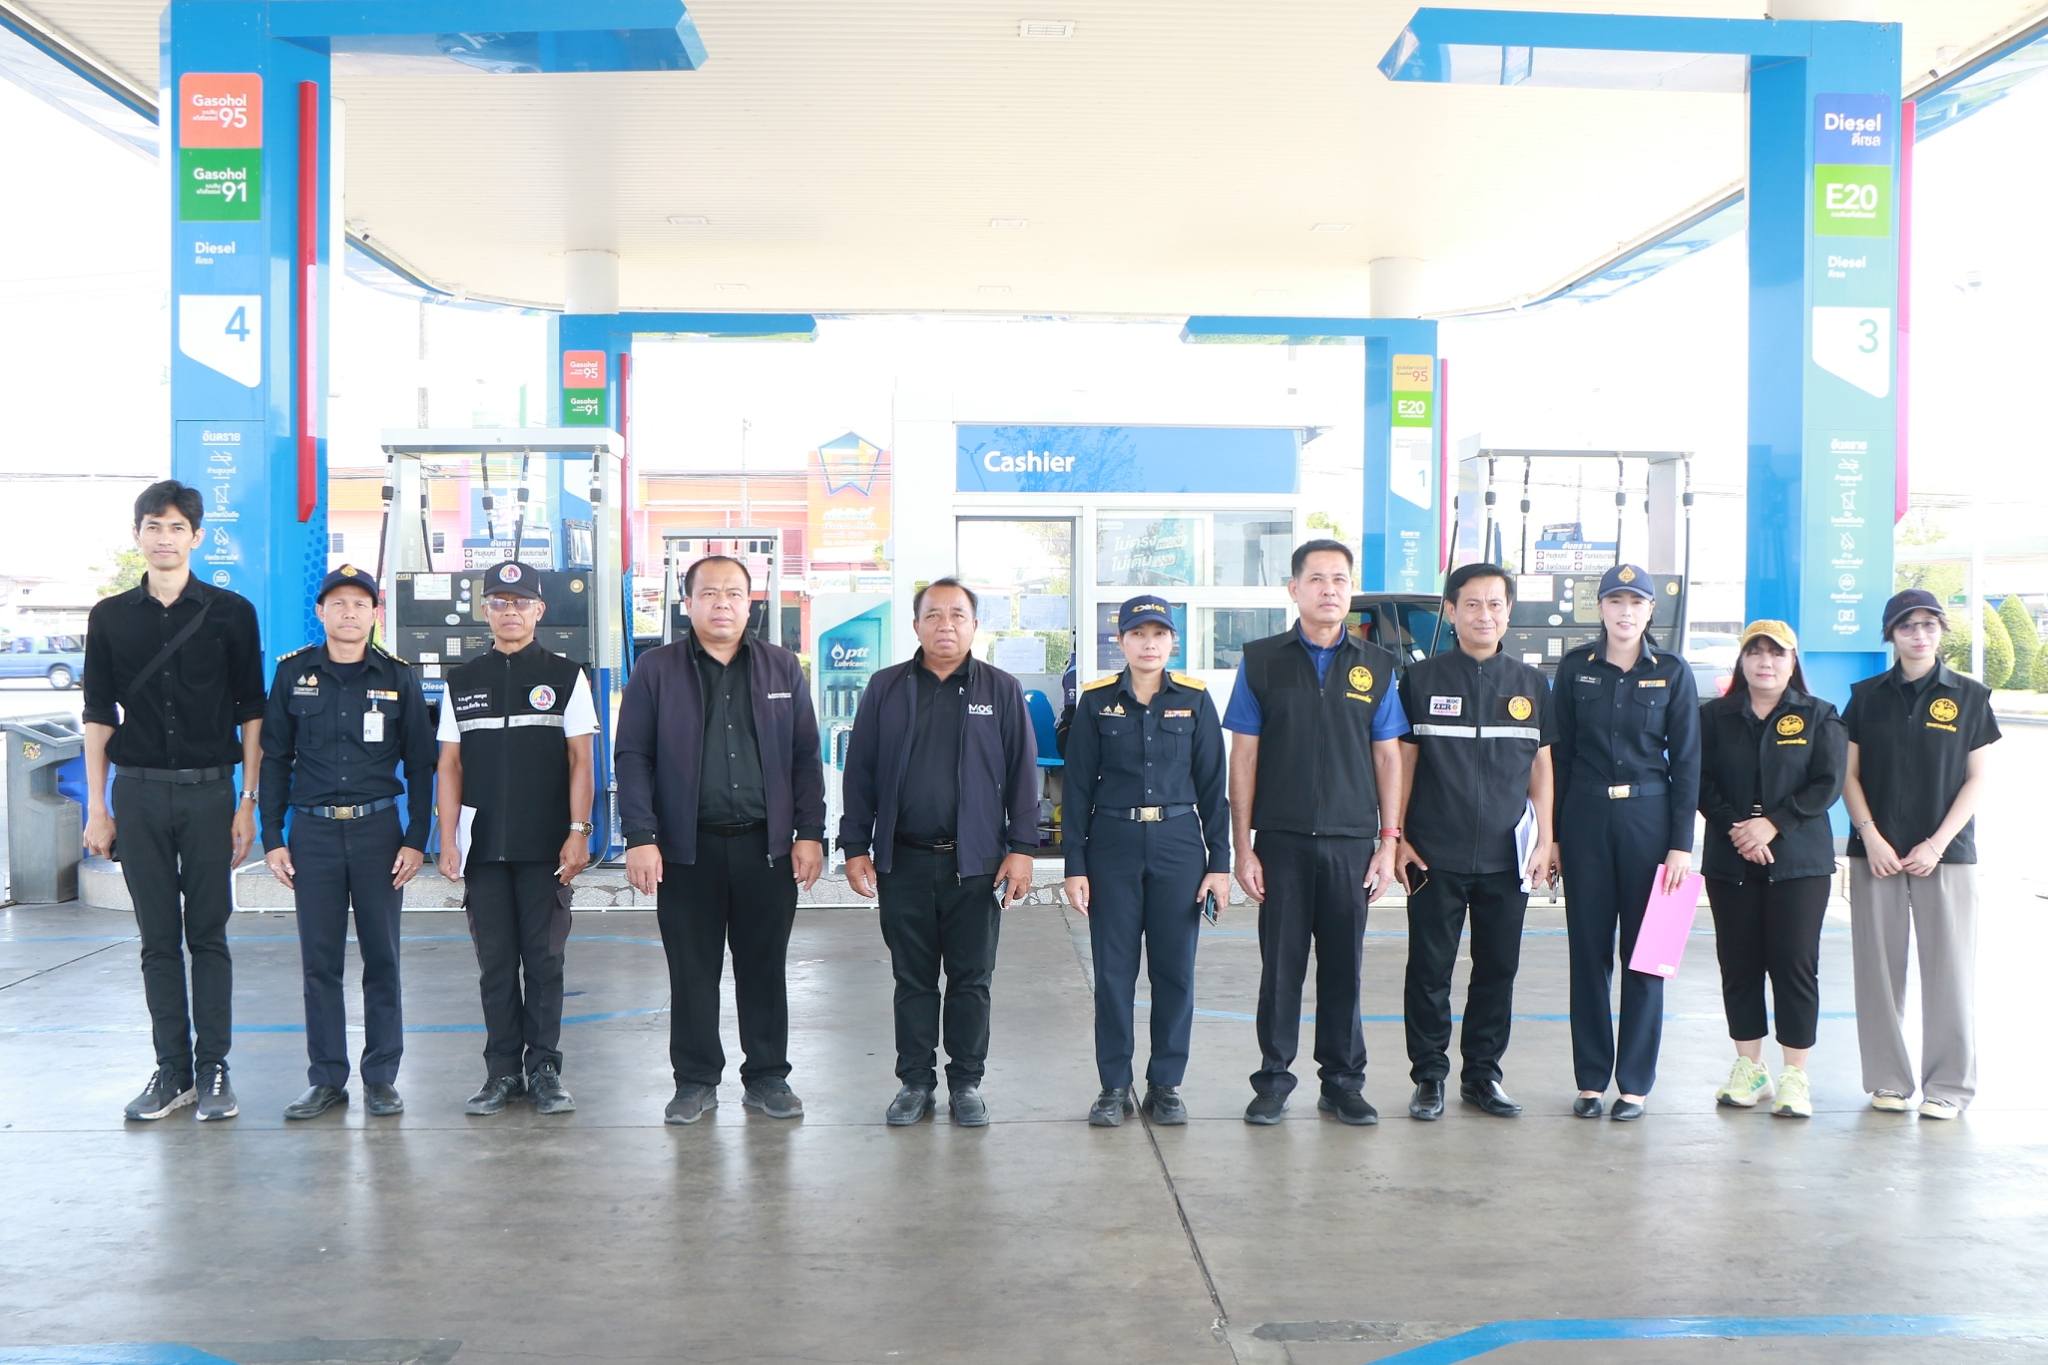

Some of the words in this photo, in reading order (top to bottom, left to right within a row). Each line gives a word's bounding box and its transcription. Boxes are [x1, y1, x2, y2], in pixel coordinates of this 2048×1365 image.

[192, 93, 248, 107] Gasohol
[218, 107, 248, 129] 95
[1824, 112, 1882, 132] Diesel
[1850, 132, 1881, 147] ดีเซล
[193, 167, 247, 180] Gasohol
[221, 181, 247, 203] 91
[1826, 183, 1878, 211] E20
[194, 240, 236, 255] Diesel
[1827, 255, 1867, 269] Diesel
[224, 305, 251, 342] 4
[1857, 318, 1879, 354] 3
[570, 360, 599, 369] Gasohol
[583, 367, 599, 379] 95
[1412, 370, 1429, 382] 95
[570, 397, 599, 405] Gasohol
[1397, 399, 1426, 415] E20
[584, 404, 599, 416] 91
[983, 449, 1076, 473] Cashier
[1418, 469, 1426, 488] 1
[845, 647, 869, 660] ptt
[422, 682, 446, 691] Diese
